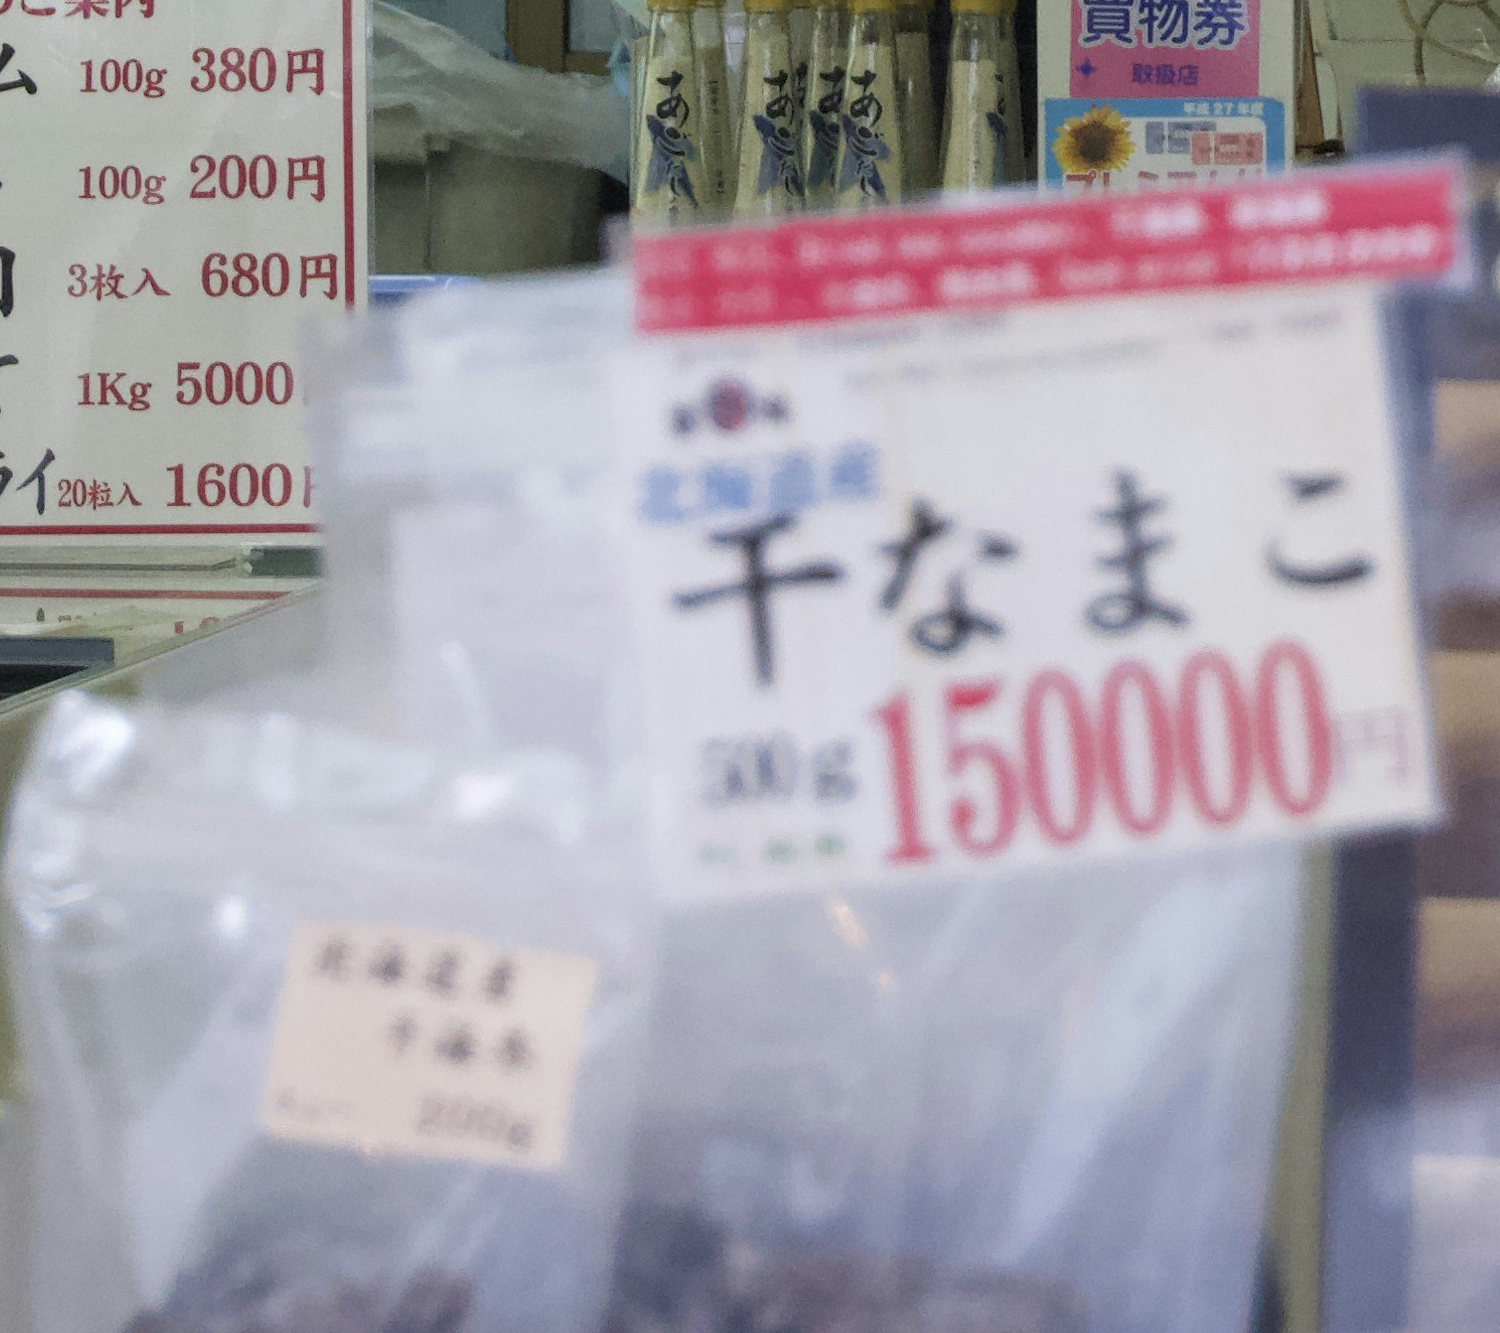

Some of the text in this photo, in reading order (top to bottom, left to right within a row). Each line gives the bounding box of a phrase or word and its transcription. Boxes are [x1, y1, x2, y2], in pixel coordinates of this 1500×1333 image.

[78, 59, 167, 99] 100g
[190, 46, 327, 97] 380円
[1131, 62, 1201, 86] 取扱店
[77, 165, 166, 205] 100g
[189, 153, 327, 203] 200円
[67, 263, 171, 302] 3枚入
[201, 251, 340, 302] 680円
[75, 370, 152, 412] 1Kg
[174, 361, 300, 408] 5000
[57, 479, 143, 510] 20粒入
[671, 467, 1374, 692] 干なまこ
